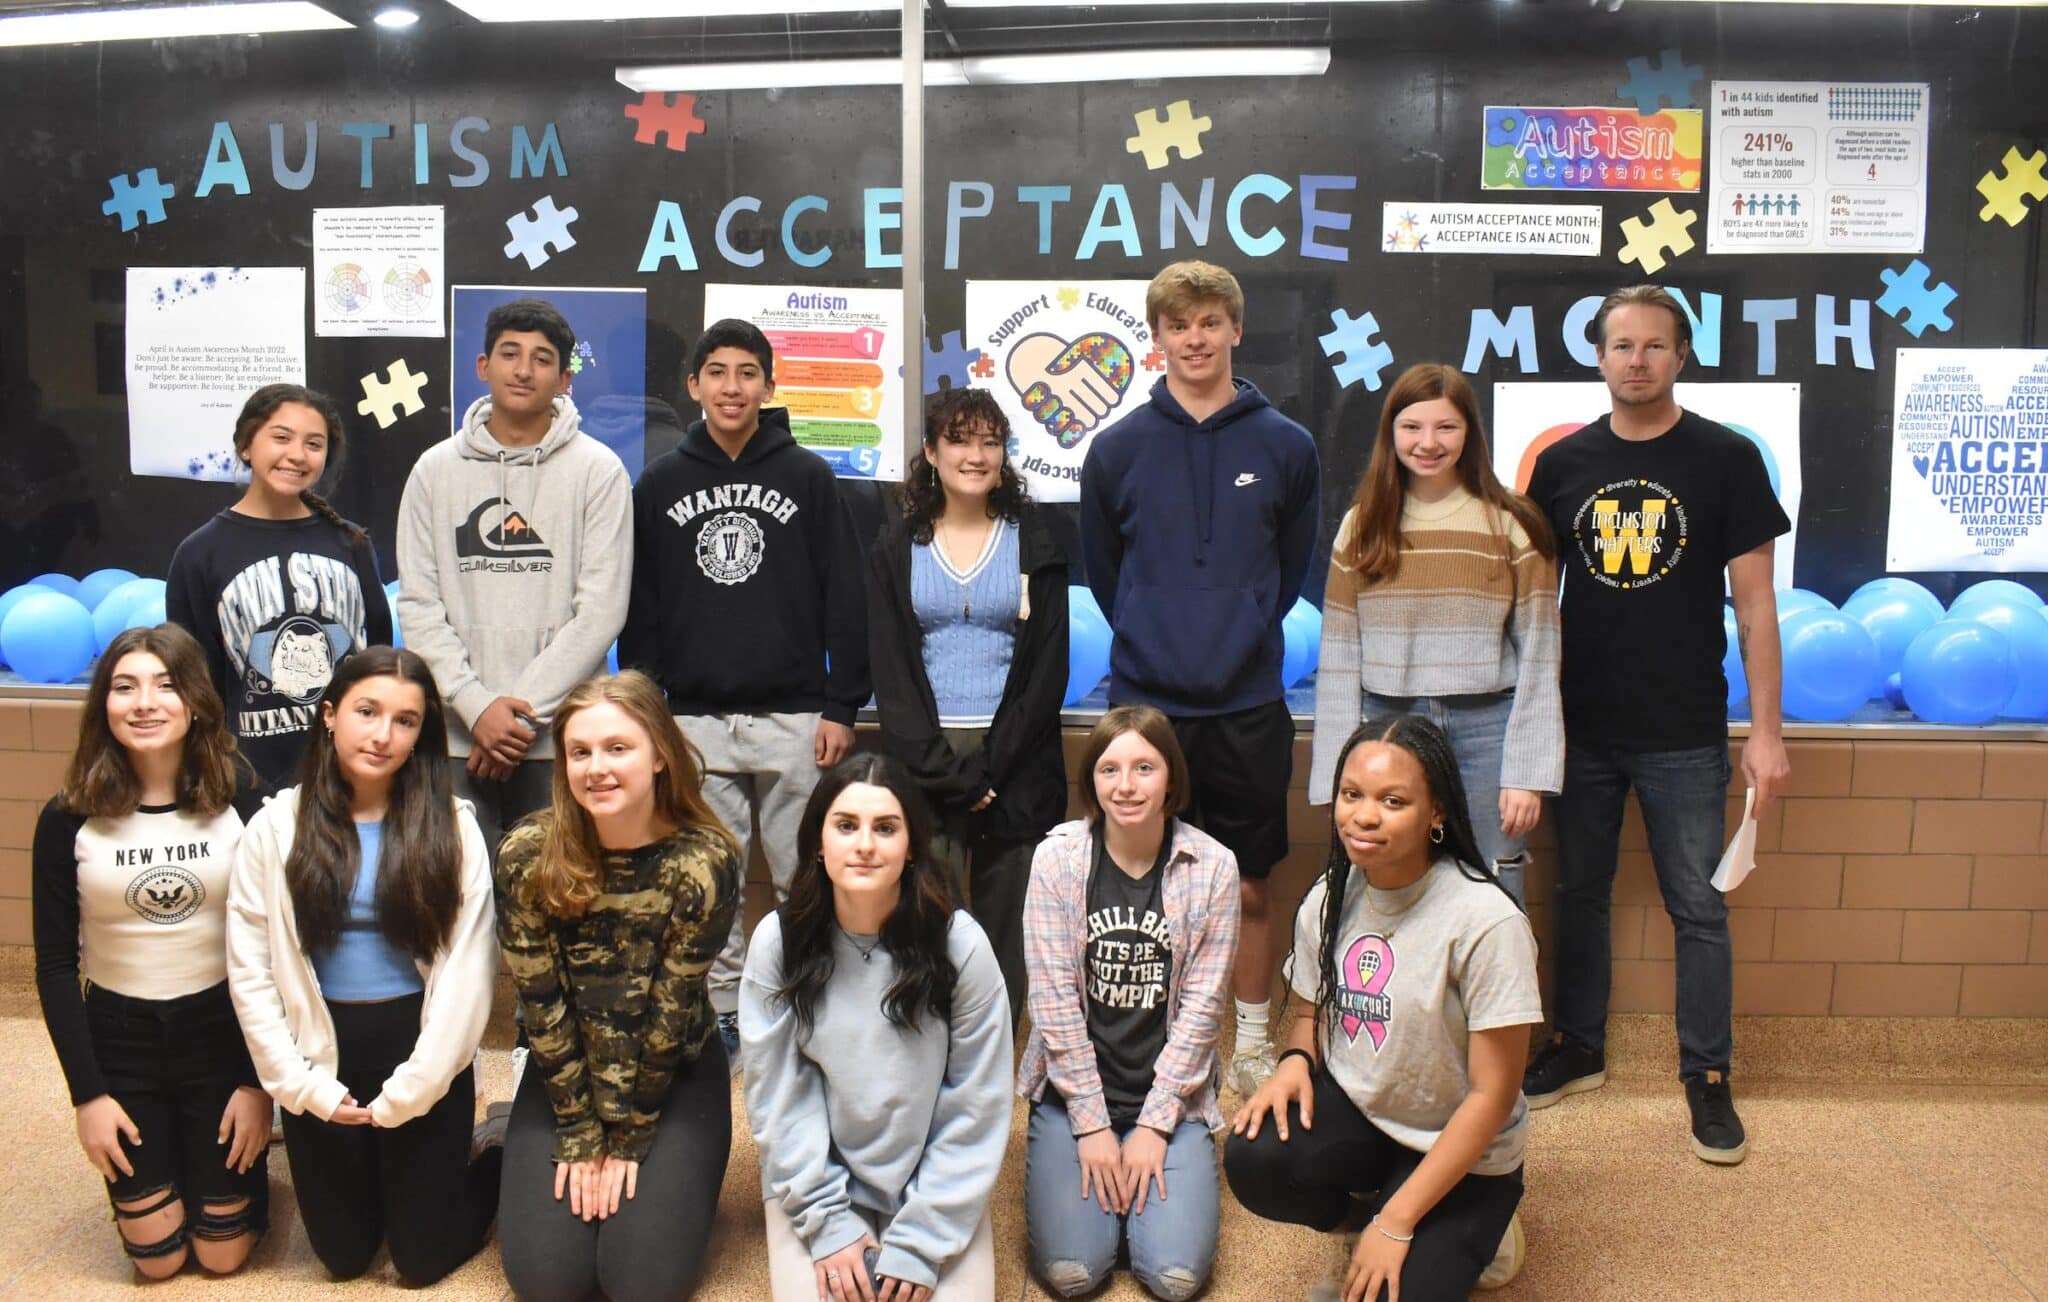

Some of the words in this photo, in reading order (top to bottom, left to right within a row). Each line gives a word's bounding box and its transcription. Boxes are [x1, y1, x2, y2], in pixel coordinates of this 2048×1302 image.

[1720, 89, 1727, 102] 1
[1729, 92, 1738, 102] in
[1740, 92, 1752, 102] 44
[1755, 92, 1774, 102] kids
[1776, 92, 1819, 103] identified
[1720, 106, 1741, 117] with
[1743, 106, 1774, 117] autism
[1514, 115, 1675, 160] Autism
[1744, 132, 1793, 152] 241%
[194, 116, 568, 198] AUTISM
[1731, 157, 1754, 168] higher
[1756, 157, 1773, 167] than
[1774, 157, 1805, 167] baseline
[1504, 160, 1681, 183] Acceptance
[1743, 170, 1760, 179] stats
[1762, 170, 1770, 179] in
[1772, 170, 1792, 179] 2000
[1868, 162, 1876, 178] 4
[636, 172, 1357, 272] ACCEPTANCE
[1430, 213, 1474, 225] AUTISM
[1476, 214, 1552, 226] ACCEPTANCE
[1555, 215, 1601, 228] MONTH:
[1723, 220, 1741, 228] BOYS
[1742, 220, 1753, 228] are
[1754, 220, 1763, 228] 4X
[1765, 220, 1781, 228] more
[1783, 220, 1800, 228] likely
[1802, 220, 1808, 228] to
[1436, 230, 1512, 243] ACCEPTANCE
[1515, 232, 1527, 243] IS
[1529, 232, 1545, 244] AN
[1548, 232, 1594, 246] ACTION.
[1726, 230, 1734, 238] be
[1736, 230, 1768, 238] diagnosed
[1770, 230, 1784, 238] than
[1785, 230, 1804, 238] GIRLS
[1829, 226, 1848, 236] 31%
[787, 292, 848, 310] Autism
[987, 294, 1051, 348] Support
[1085, 291, 1150, 343] Educate
[149, 345, 167, 354] April
[176, 345, 201, 353] Autism
[203, 345, 240, 353] Awareness
[241, 346, 266, 354] Month
[266, 346, 286, 354] 2022
[863, 332, 874, 353] 1
[171, 354, 180, 362] be
[134, 364, 144, 372] Be
[170, 364, 180, 372] Be
[242, 365, 252, 373] Be
[286, 366, 296, 374] Be
[149, 382, 158, 390] Be
[201, 382, 211, 390] Be
[179, 374, 188, 382] Be
[226, 374, 236, 382] Be
[1923, 374, 1974, 382] EMPOWER
[859, 389, 873, 412] 3
[1904, 394, 1984, 412] AWARENESS
[2005, 395, 2048, 410] ACCE
[1900, 413, 1951, 422] COMMUNITY
[1898, 422, 1949, 430] RESOURCES
[1950, 414, 2016, 439] AUTISM
[1901, 432, 1949, 440] UNDERSTAND
[1907, 442, 1935, 454] ACCEPT
[858, 448, 873, 472] 5
[1022, 455, 1082, 483] Accept
[1932, 474, 2048, 496] UNDERSTAN
[666, 483, 800, 528] WANTAGH
[1960, 514, 2043, 526] AWARENESS
[1967, 526, 2029, 536] EMPOWER
[722, 531, 740, 561] W
[1594, 536, 1663, 554] MATTERS
[1976, 538, 2015, 547] AUTISM
[1984, 548, 2005, 556] ACCEPT
[459, 558, 553, 573] QUIKSILVER
[116, 848, 154, 867] NEW
[164, 841, 210, 862] YORK
[1096, 940, 1131, 962] IT'S
[1134, 942, 1160, 962] P.E.
[1128, 962, 1164, 983] THE
[1088, 975, 1168, 1009] LYMPIC
[1362, 994, 1390, 1020] CURE
